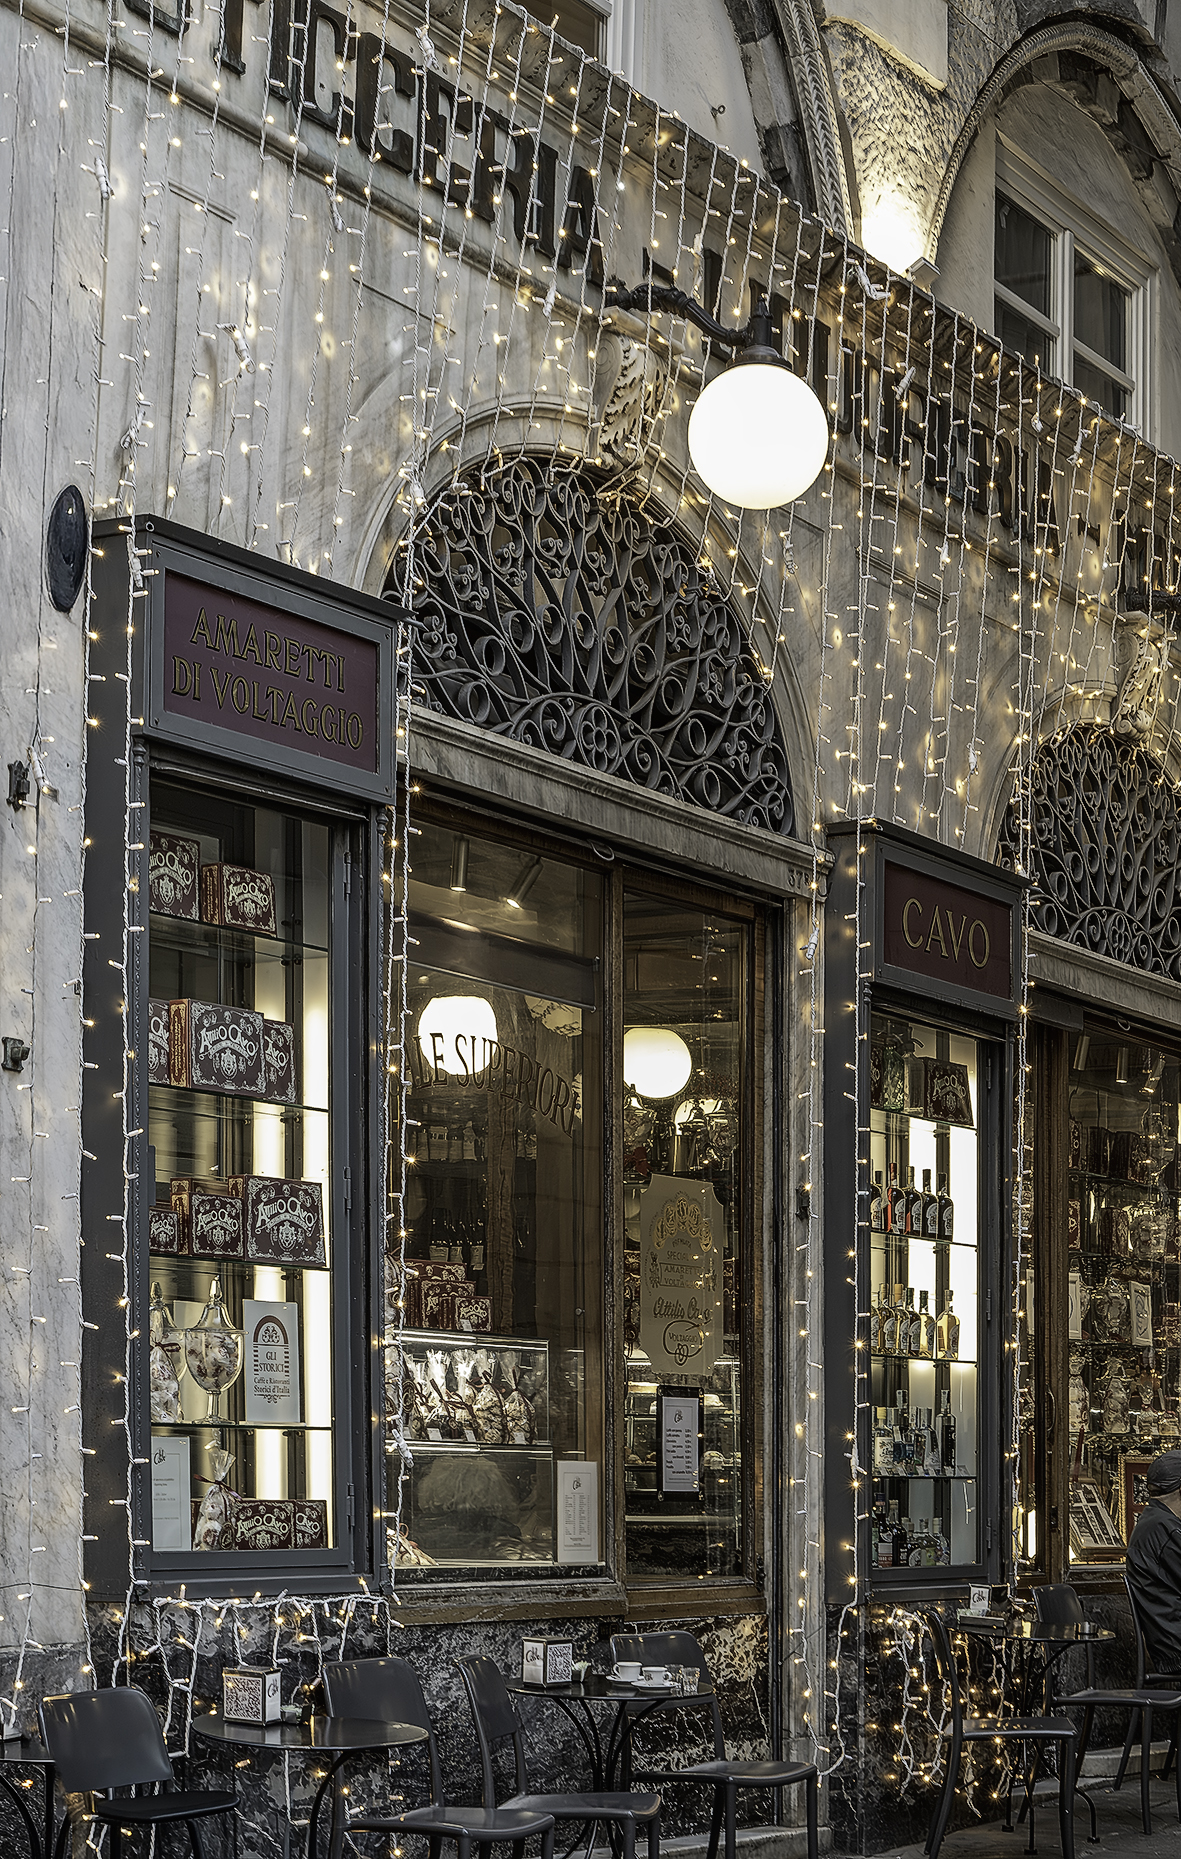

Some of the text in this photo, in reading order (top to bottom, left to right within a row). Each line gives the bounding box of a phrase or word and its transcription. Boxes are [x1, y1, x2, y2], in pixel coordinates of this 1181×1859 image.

[190, 607, 345, 693] AMARETTI
[171, 656, 363, 750] DI VOLTAGGIO
[902, 897, 989, 969] CAVO
[455, 1033, 580, 1138] SUPERIORI
[253, 1385, 271, 1394] Storici
[259, 1362, 285, 1373] STORICI
[266, 1351, 277, 1361] GLI
